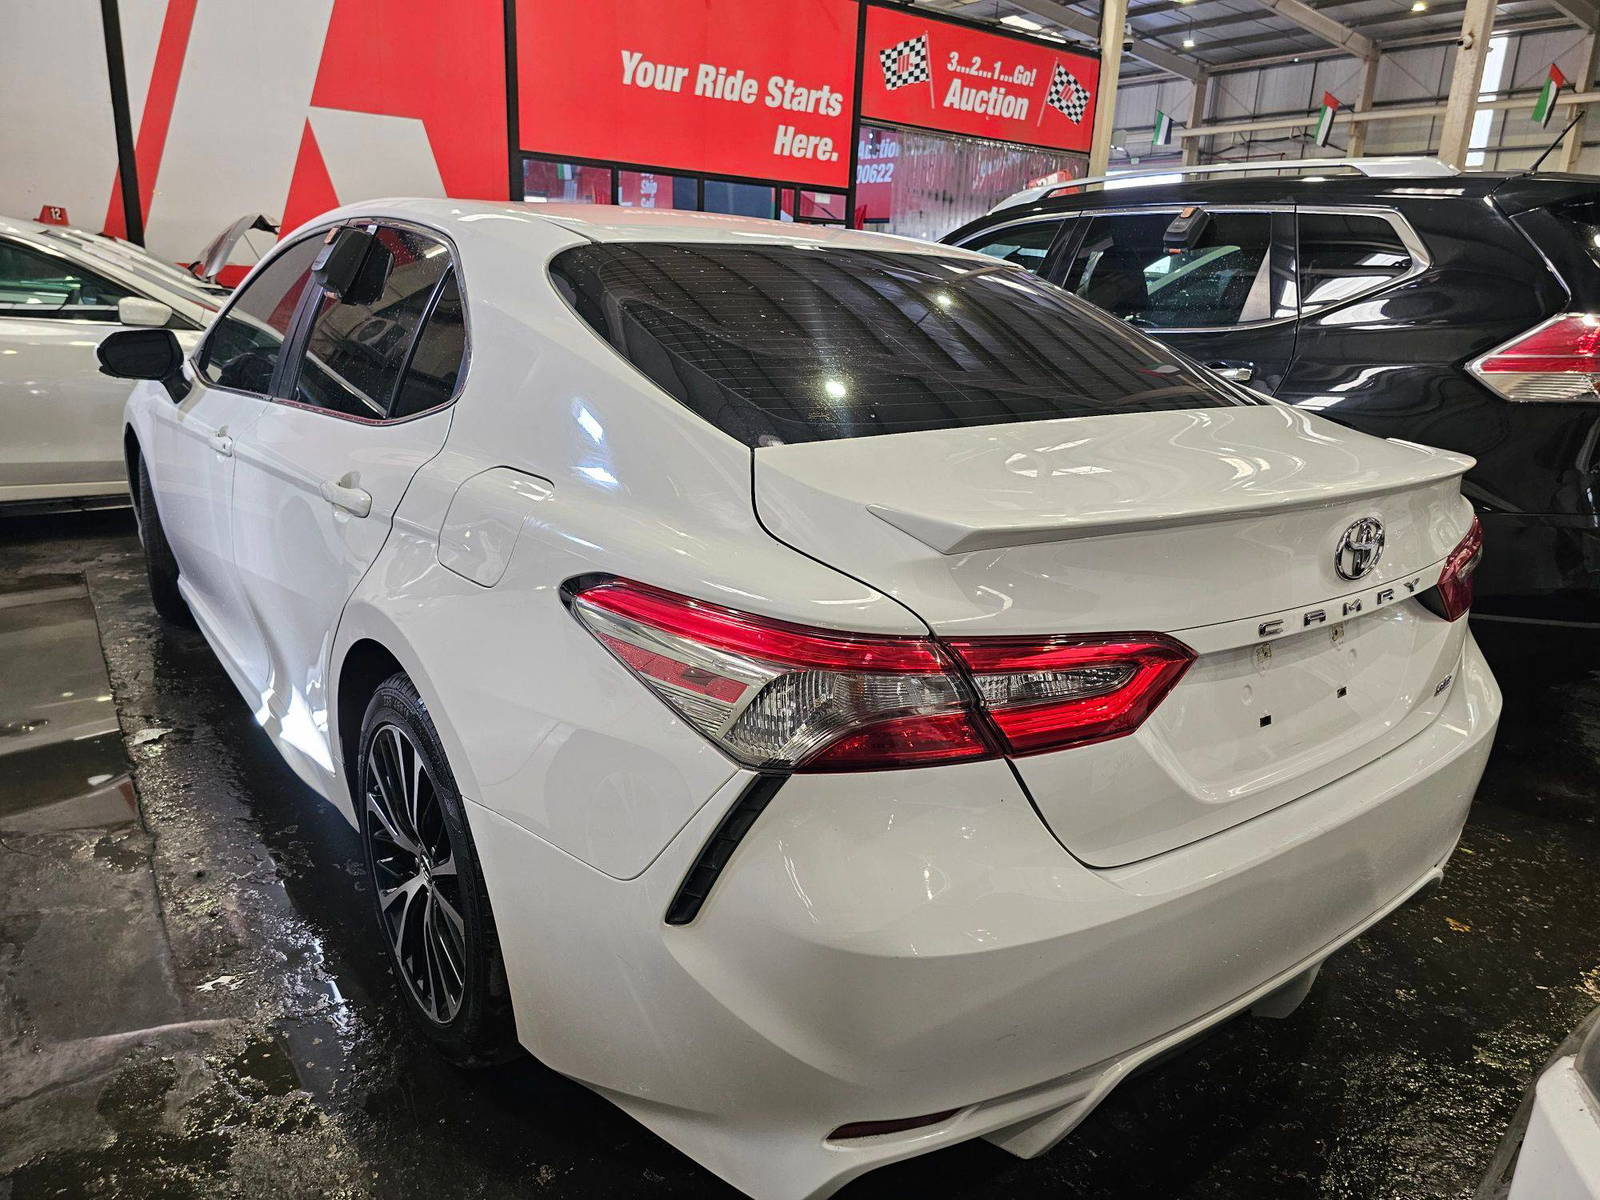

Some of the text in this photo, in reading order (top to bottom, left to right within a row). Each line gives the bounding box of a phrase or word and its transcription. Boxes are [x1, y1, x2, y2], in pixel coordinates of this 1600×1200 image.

[621, 50, 843, 117] Your Ride Starts
[943, 78, 1029, 121] Auction
[773, 125, 838, 162] Here.
[50, 207, 61, 221] 12
[1258, 577, 1421, 638] CAMRY
